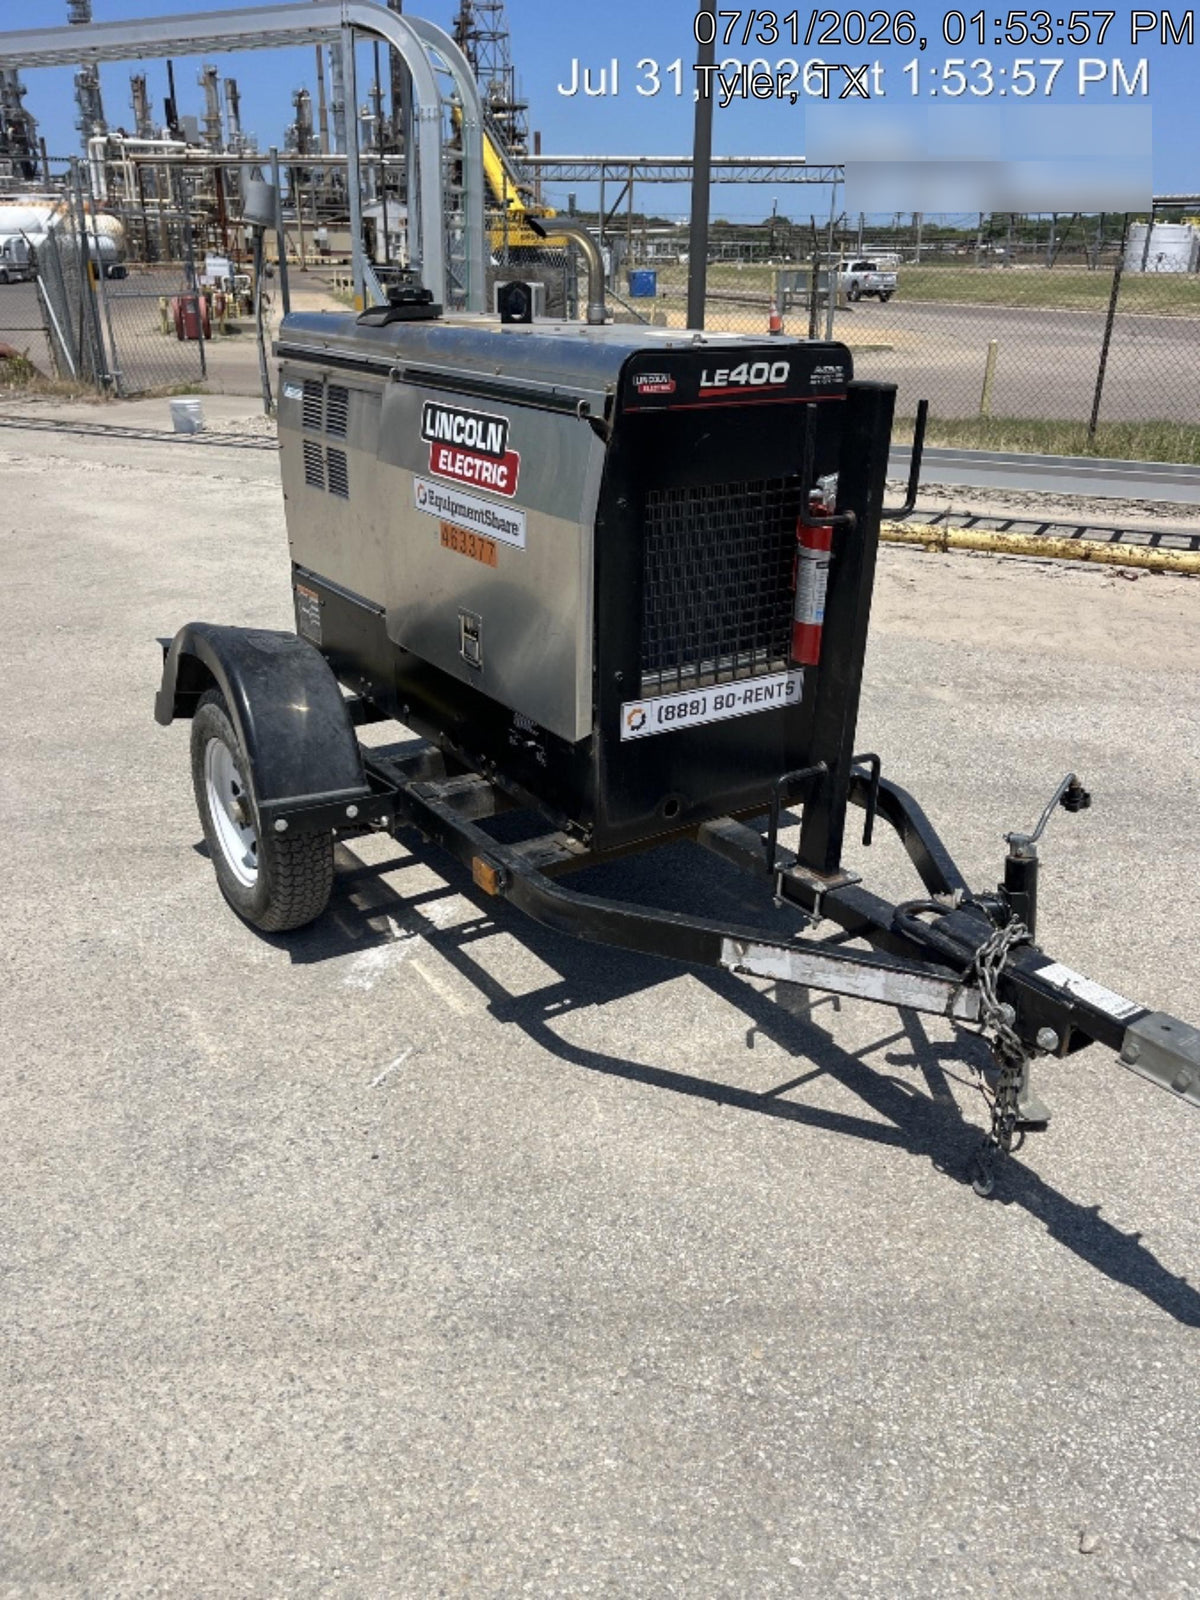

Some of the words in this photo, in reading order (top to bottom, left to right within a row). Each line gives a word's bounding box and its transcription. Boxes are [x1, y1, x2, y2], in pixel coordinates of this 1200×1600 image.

[700, 361, 790, 387] LE400
[425, 408, 504, 454] LINCOLN
[438, 449, 509, 488] ELECTRIC
[428, 489, 520, 537] EquipmentShare
[657, 697, 707, 725] (888)
